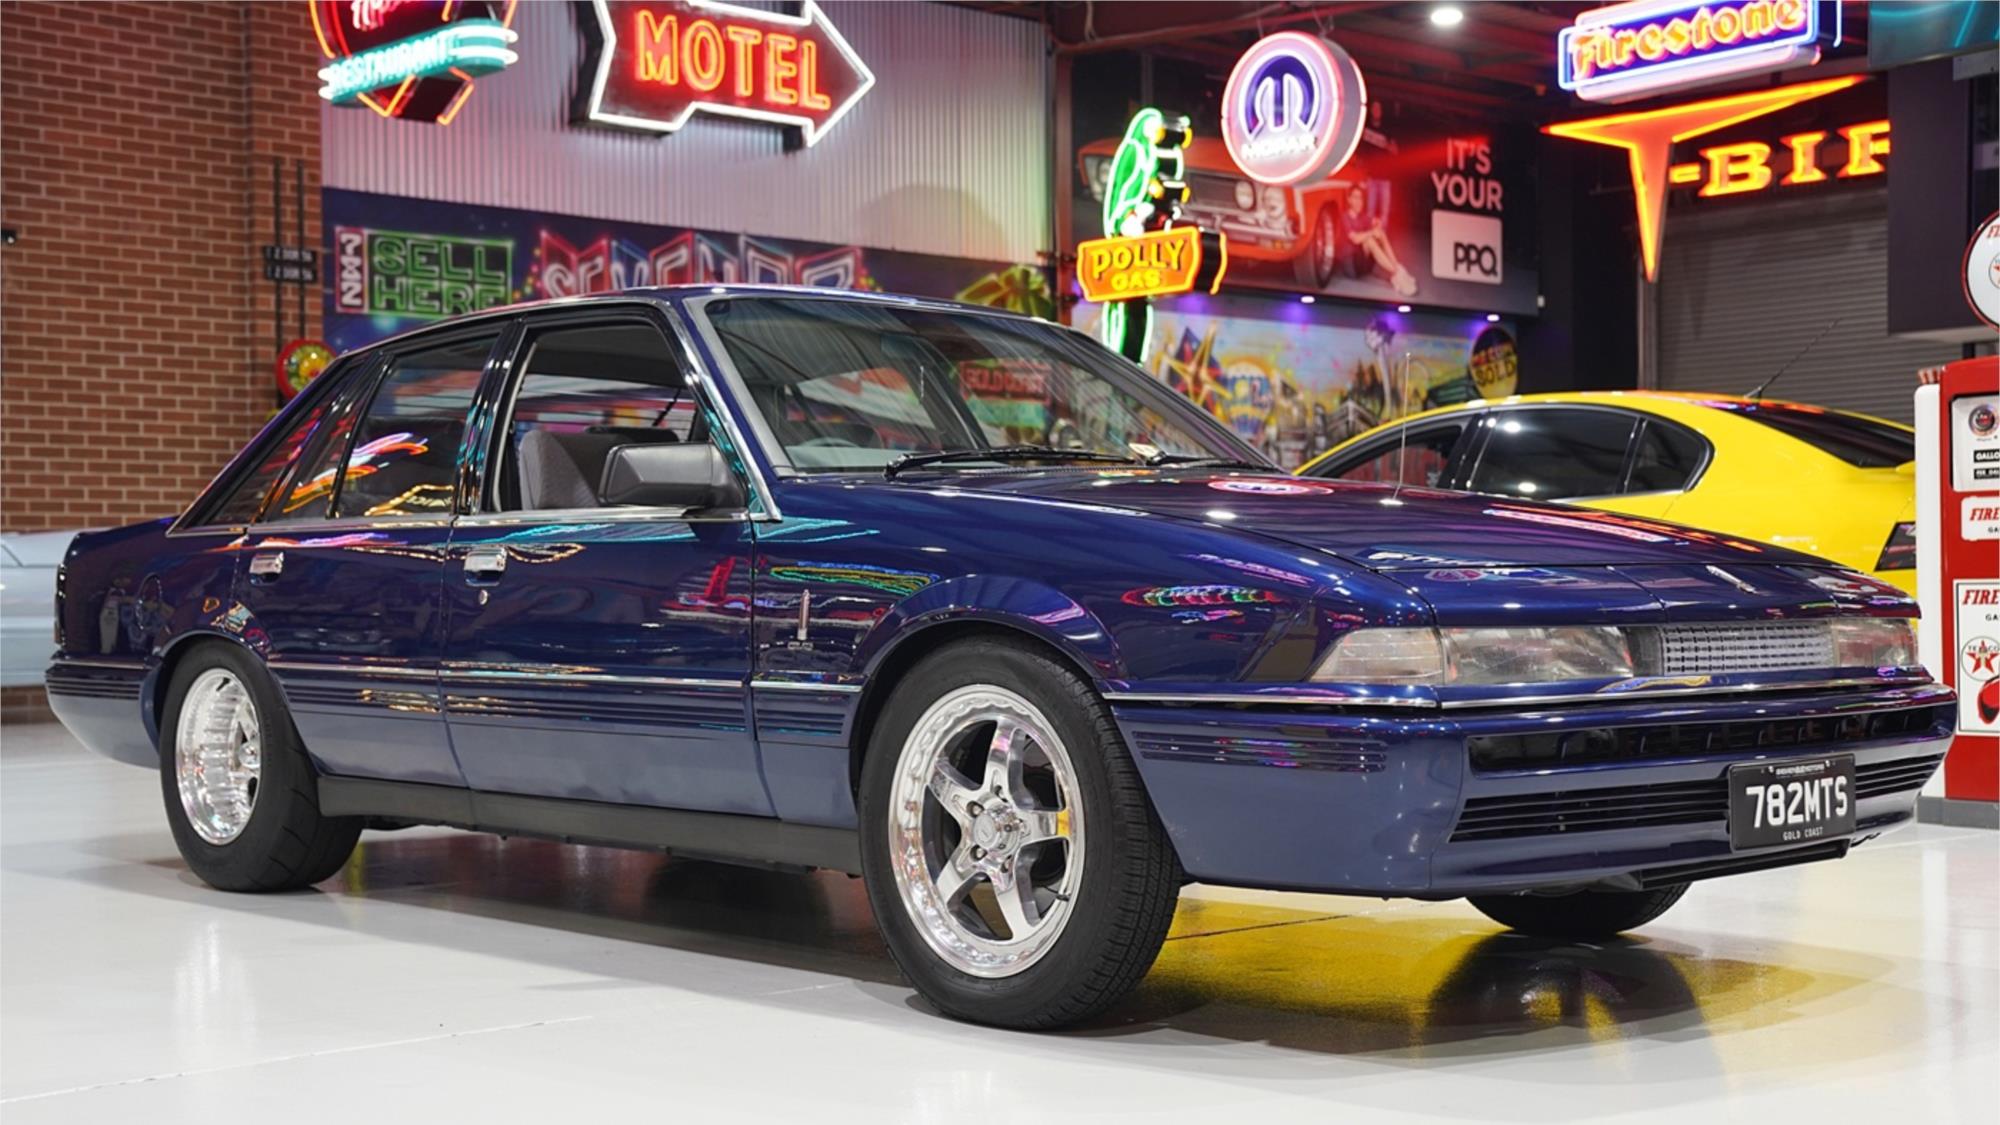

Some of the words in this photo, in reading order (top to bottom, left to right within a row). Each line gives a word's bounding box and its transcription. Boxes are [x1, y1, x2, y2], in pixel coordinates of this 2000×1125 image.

[635, 9, 832, 111] MOTEL
[1572, 0, 1806, 80] Firestone
[1447, 138, 1492, 175] IT'S
[1431, 171, 1503, 211] YOUR
[374, 236, 506, 284] SELL
[1089, 239, 1185, 280] POLLY
[1454, 242, 1498, 276] PPQ
[374, 275, 506, 315] HERE
[1111, 268, 1161, 291] GAS
[1962, 589, 1999, 605] FIRE
[1746, 776, 1848, 828] 782MTS
[1783, 831, 1801, 841] GOLD
[1804, 827, 1824, 838] COAST
